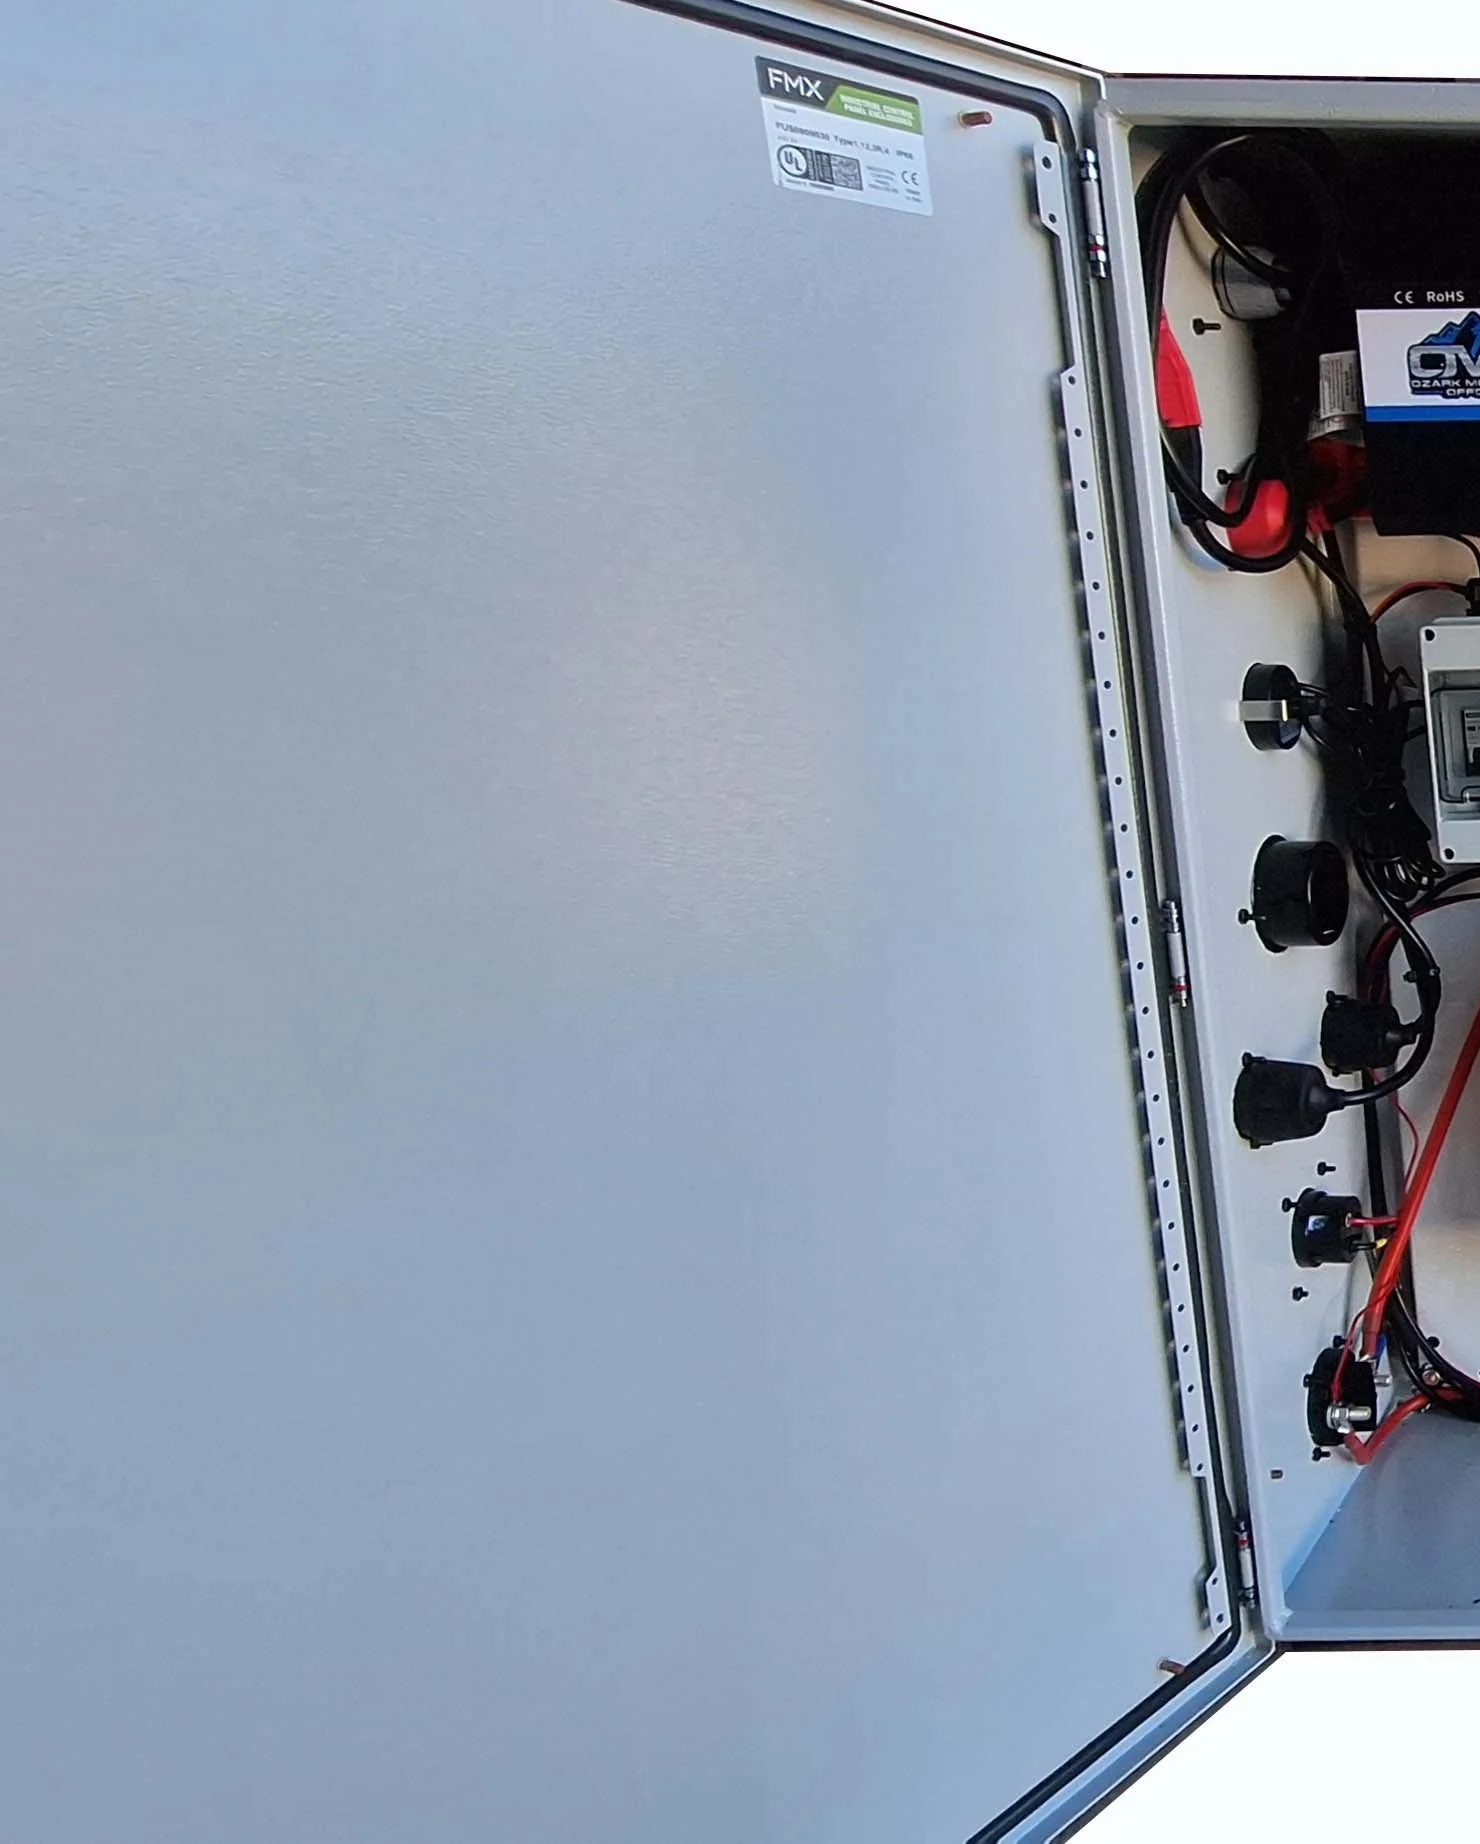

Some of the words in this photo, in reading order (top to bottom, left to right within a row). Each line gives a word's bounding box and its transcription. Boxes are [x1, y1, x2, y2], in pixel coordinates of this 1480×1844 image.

[767, 67, 824, 101] FMX
[901, 170, 920, 186] CE
[1394, 290, 1414, 304] CE
[1426, 290, 1465, 303] RoHS
[1411, 379, 1461, 388] OZARK
